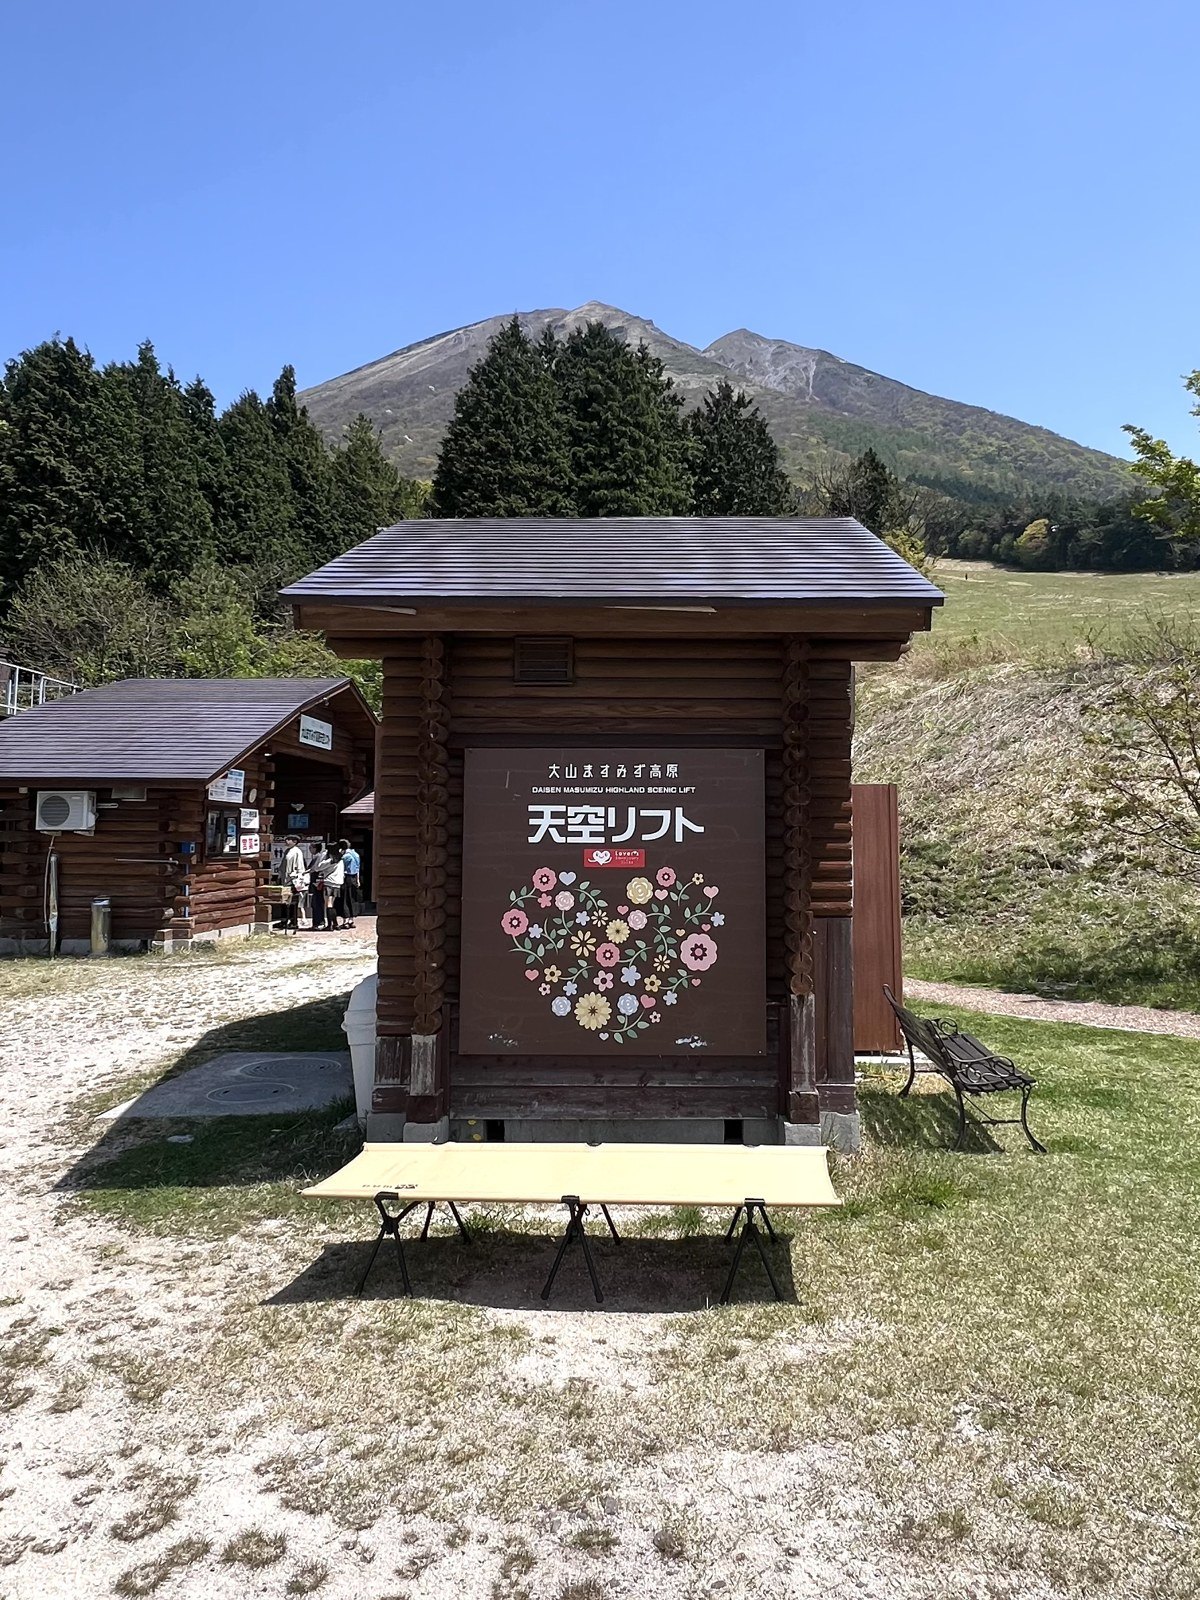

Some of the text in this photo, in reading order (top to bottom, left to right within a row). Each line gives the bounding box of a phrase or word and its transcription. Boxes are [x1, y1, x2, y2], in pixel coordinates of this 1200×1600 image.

[548, 763, 679, 779] 大山ますみず高原
[532, 786, 696, 794] DAISEN MASUMIZU HIGHLAND SCENIC LIFT
[527, 804, 705, 844] 天空リフト
